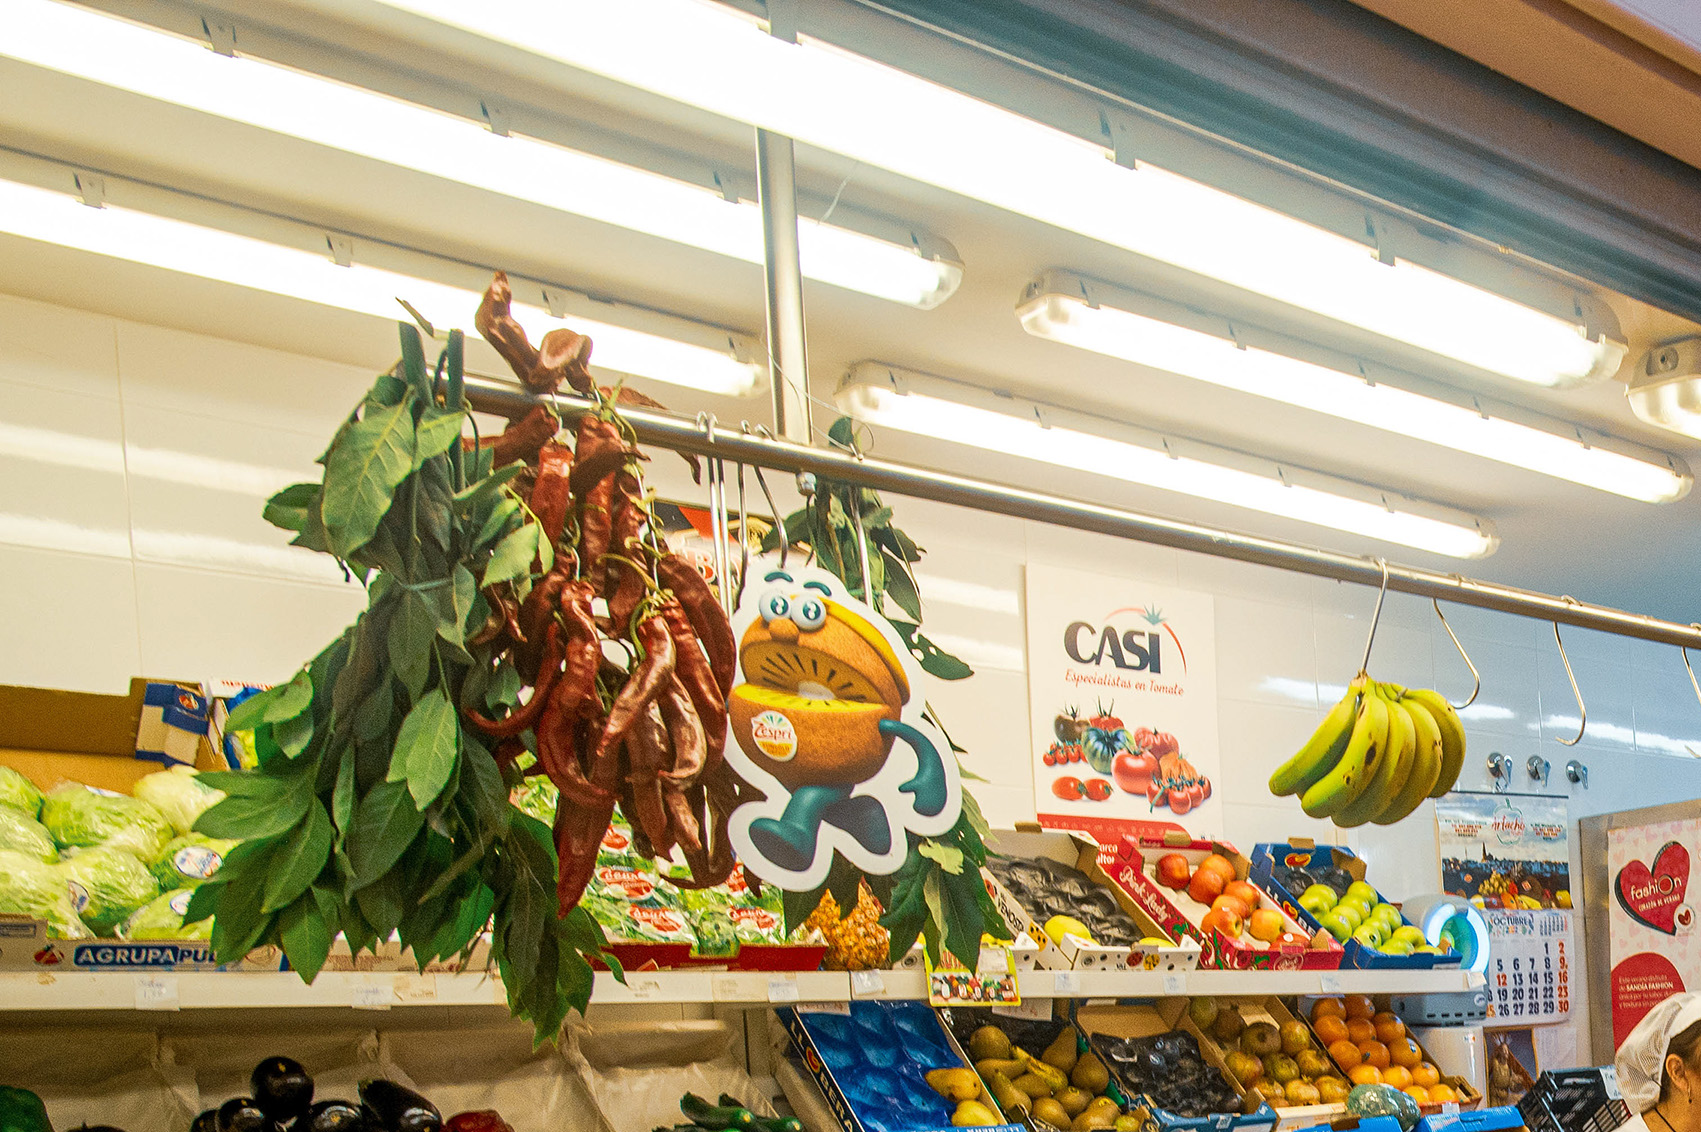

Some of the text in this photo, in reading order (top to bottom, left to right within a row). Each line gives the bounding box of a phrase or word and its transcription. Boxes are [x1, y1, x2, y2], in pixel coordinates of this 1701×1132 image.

[1063, 620, 1161, 674] CASI
[1065, 668, 1185, 697] Especialistas en Tomate
[754, 722, 792, 741] Zespri
[1493, 916, 1528, 926] OCTUBRE
[1545, 941, 1565, 954] 1 2
[1497, 956, 1566, 971] 5 6 7 8 9
[1497, 971, 1569, 986] 12 13 14 15 16
[1497, 988, 1508, 1001] 19
[1512, 988, 1524, 1000] 20
[1529, 987, 1539, 1000] 21
[1543, 986, 1554, 999] 22
[1558, 985, 1569, 998] 23
[1499, 1003, 1510, 1016] 26
[1513, 1003, 1525, 1015] 27
[1529, 1002, 1540, 1015] 28
[1543, 1001, 1555, 1014] 29
[1559, 1000, 1570, 1012] 30
